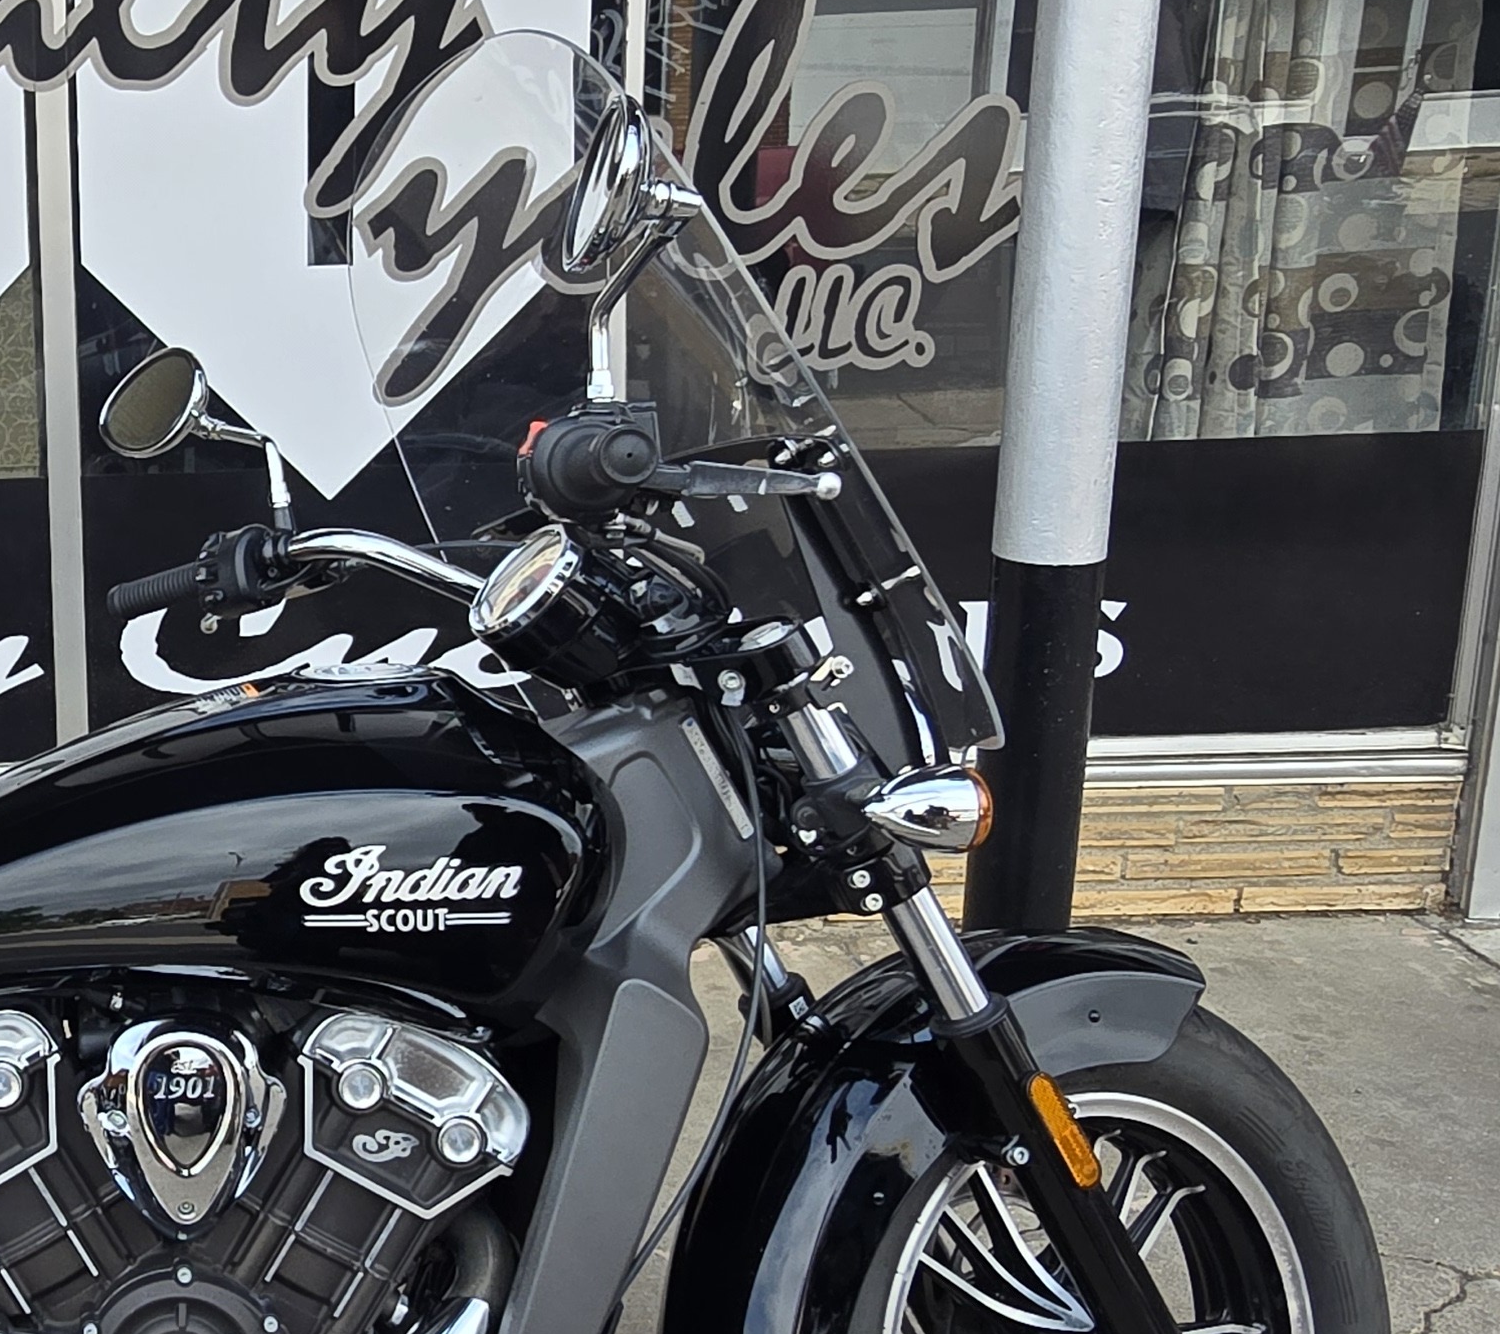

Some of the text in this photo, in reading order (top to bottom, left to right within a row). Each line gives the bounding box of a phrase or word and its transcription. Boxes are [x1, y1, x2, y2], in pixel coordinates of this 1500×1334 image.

[299, 844, 523, 908] Indian
[366, 907, 449, 933] SCOUT
[153, 1075, 216, 1100] 1901
